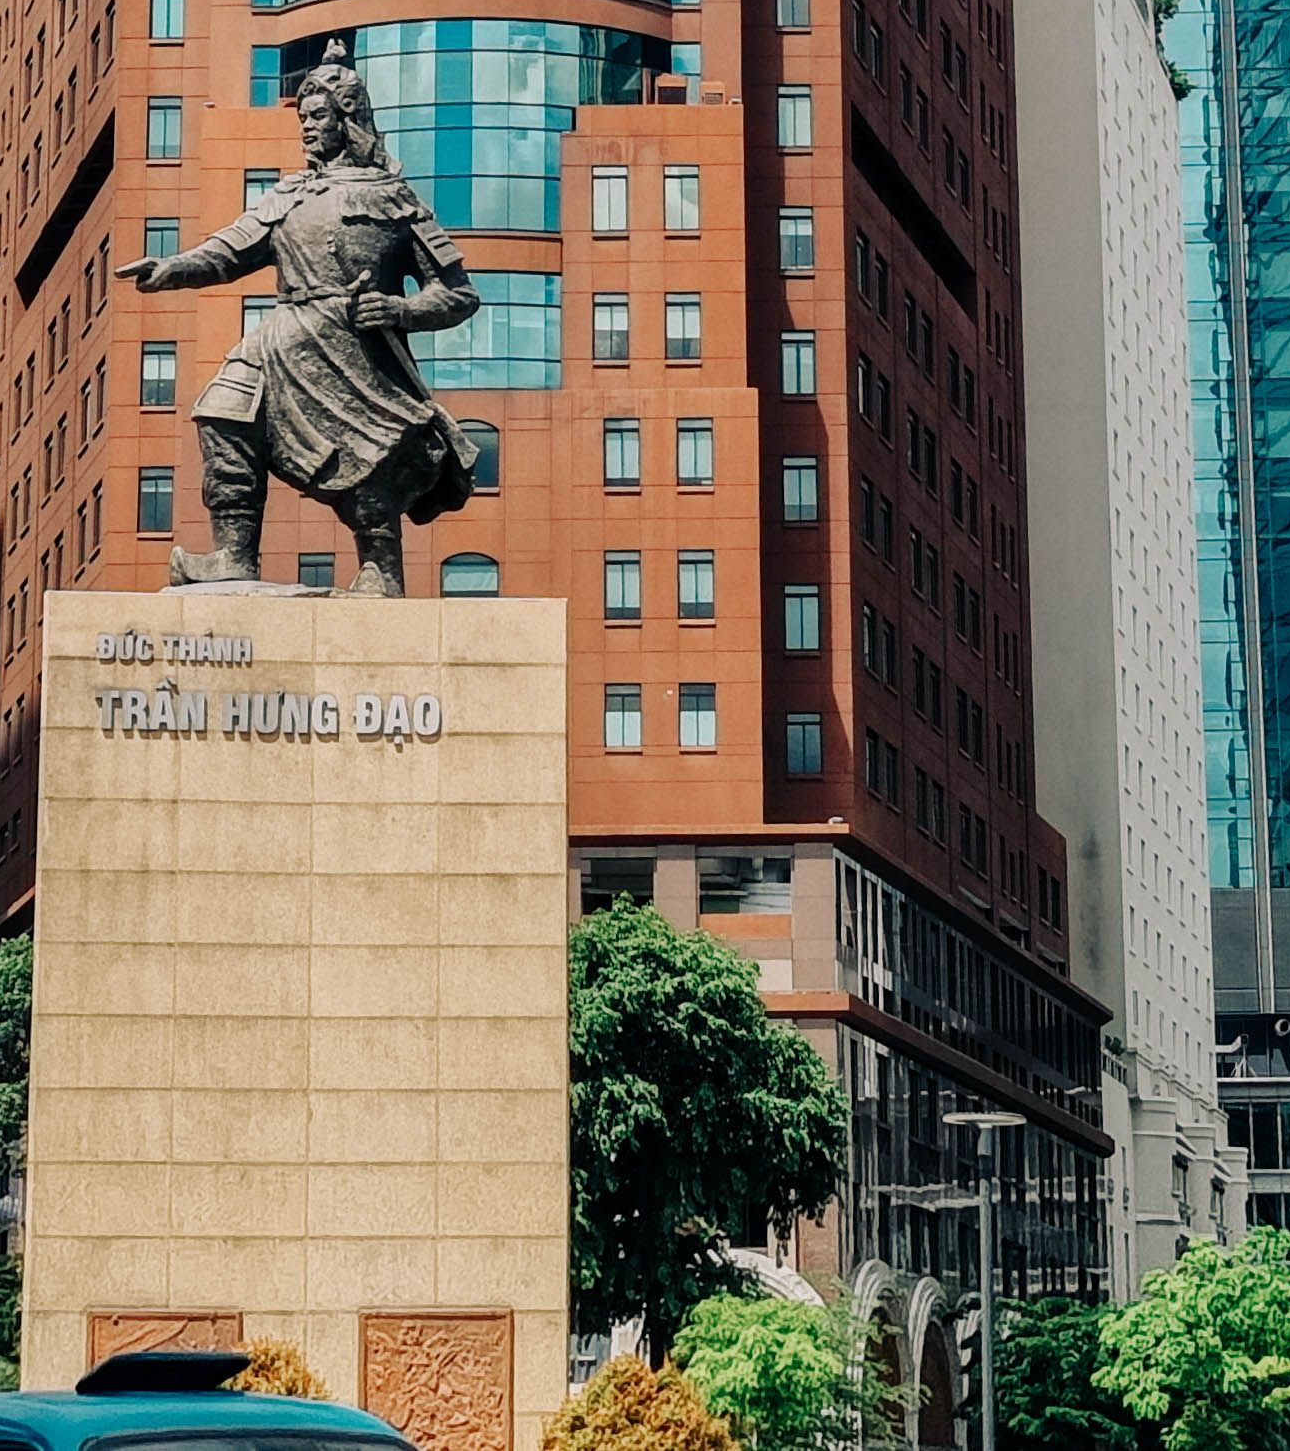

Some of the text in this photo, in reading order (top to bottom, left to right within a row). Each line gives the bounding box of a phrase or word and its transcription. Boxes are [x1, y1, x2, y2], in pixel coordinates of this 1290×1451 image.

[96, 630, 253, 663] ĐỨC THÁNH
[96, 677, 443, 746] TRẦN HƯNG ĐẠO
